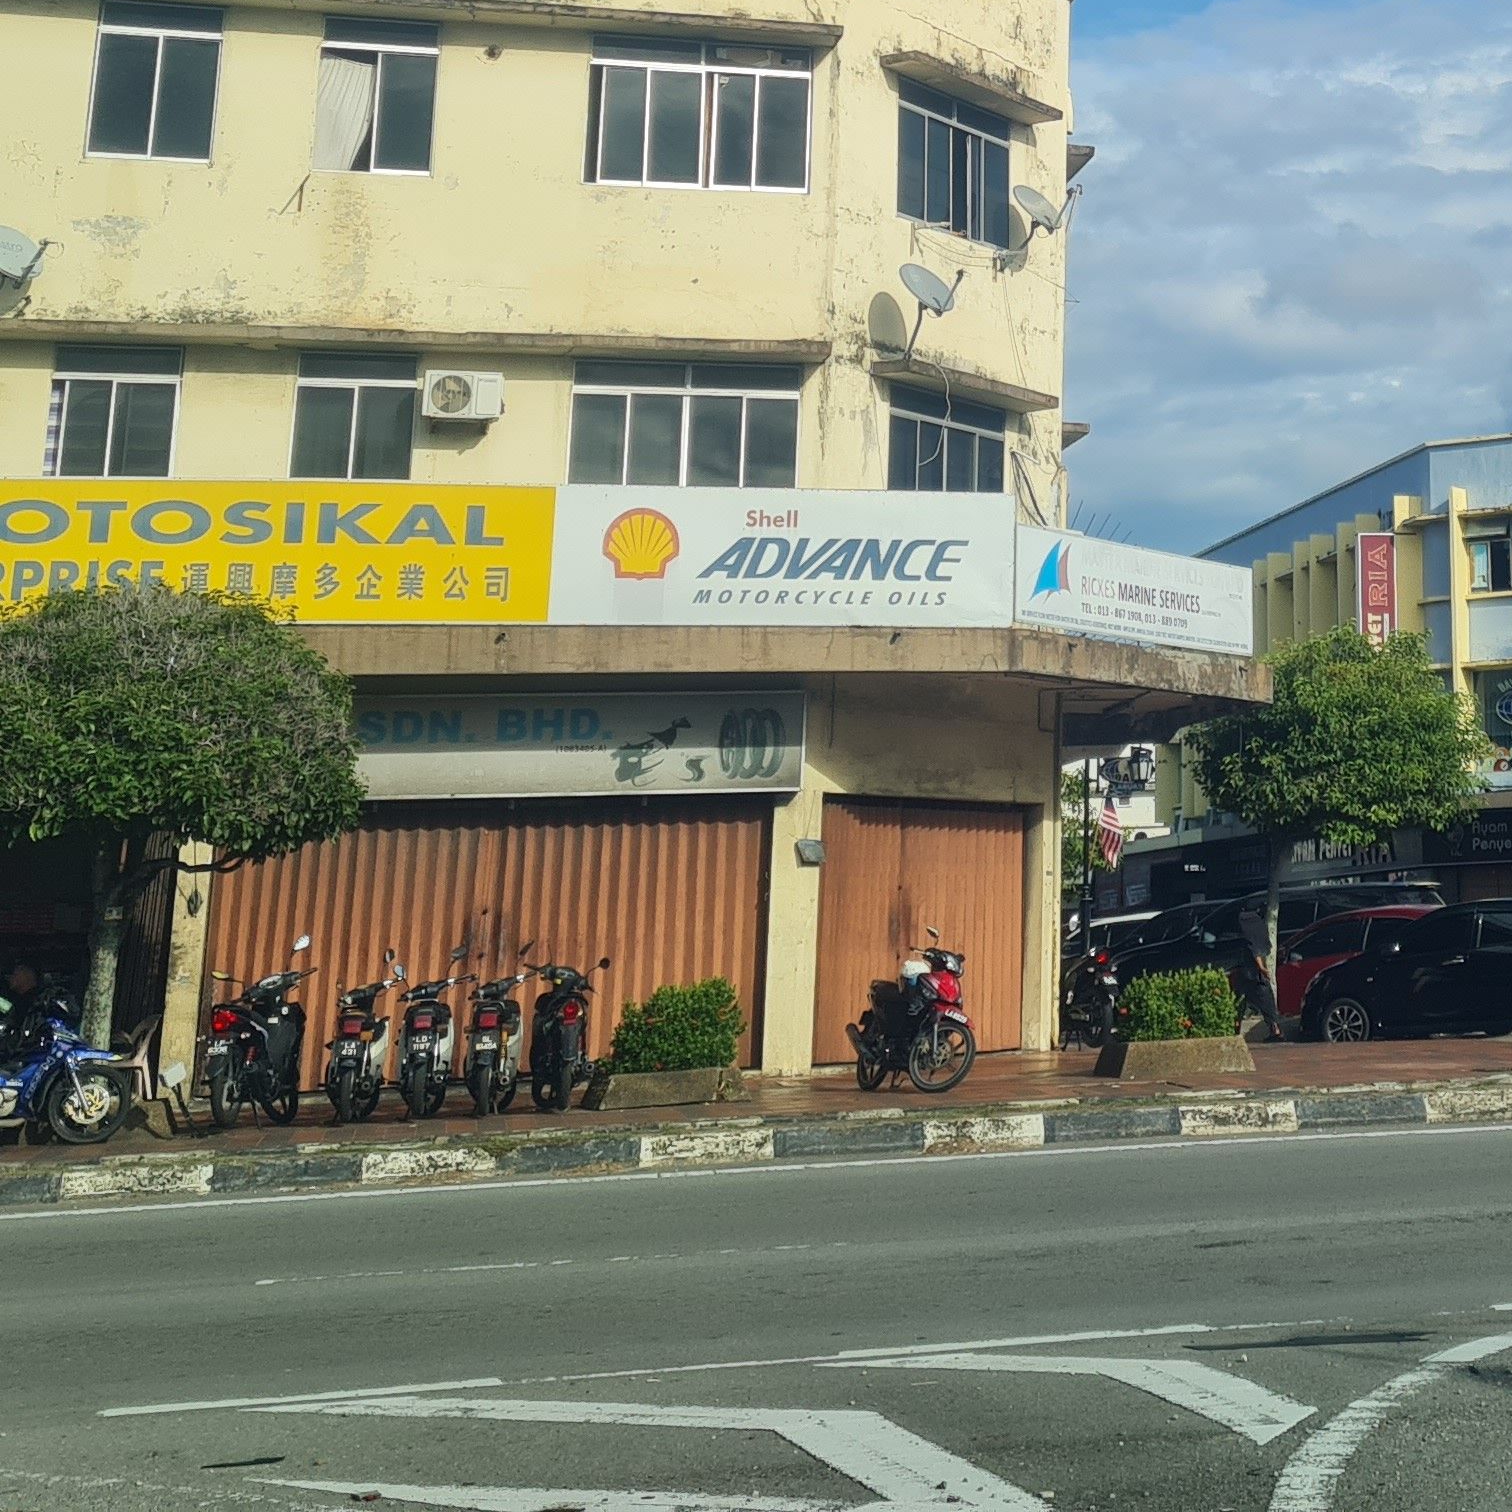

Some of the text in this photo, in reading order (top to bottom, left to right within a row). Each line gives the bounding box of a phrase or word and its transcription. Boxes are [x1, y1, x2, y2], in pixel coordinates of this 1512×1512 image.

[745, 510, 798, 528] Shell
[696, 537, 969, 581] ADVANCE
[1367, 543, 1388, 607] RIA
[692, 589, 947, 606] MOTORCYCLE OILS
[1118, 581, 1156, 607] MARINE
[1159, 587, 1201, 614] SERVICES
[357, 708, 616, 745] SDN. BHD.
